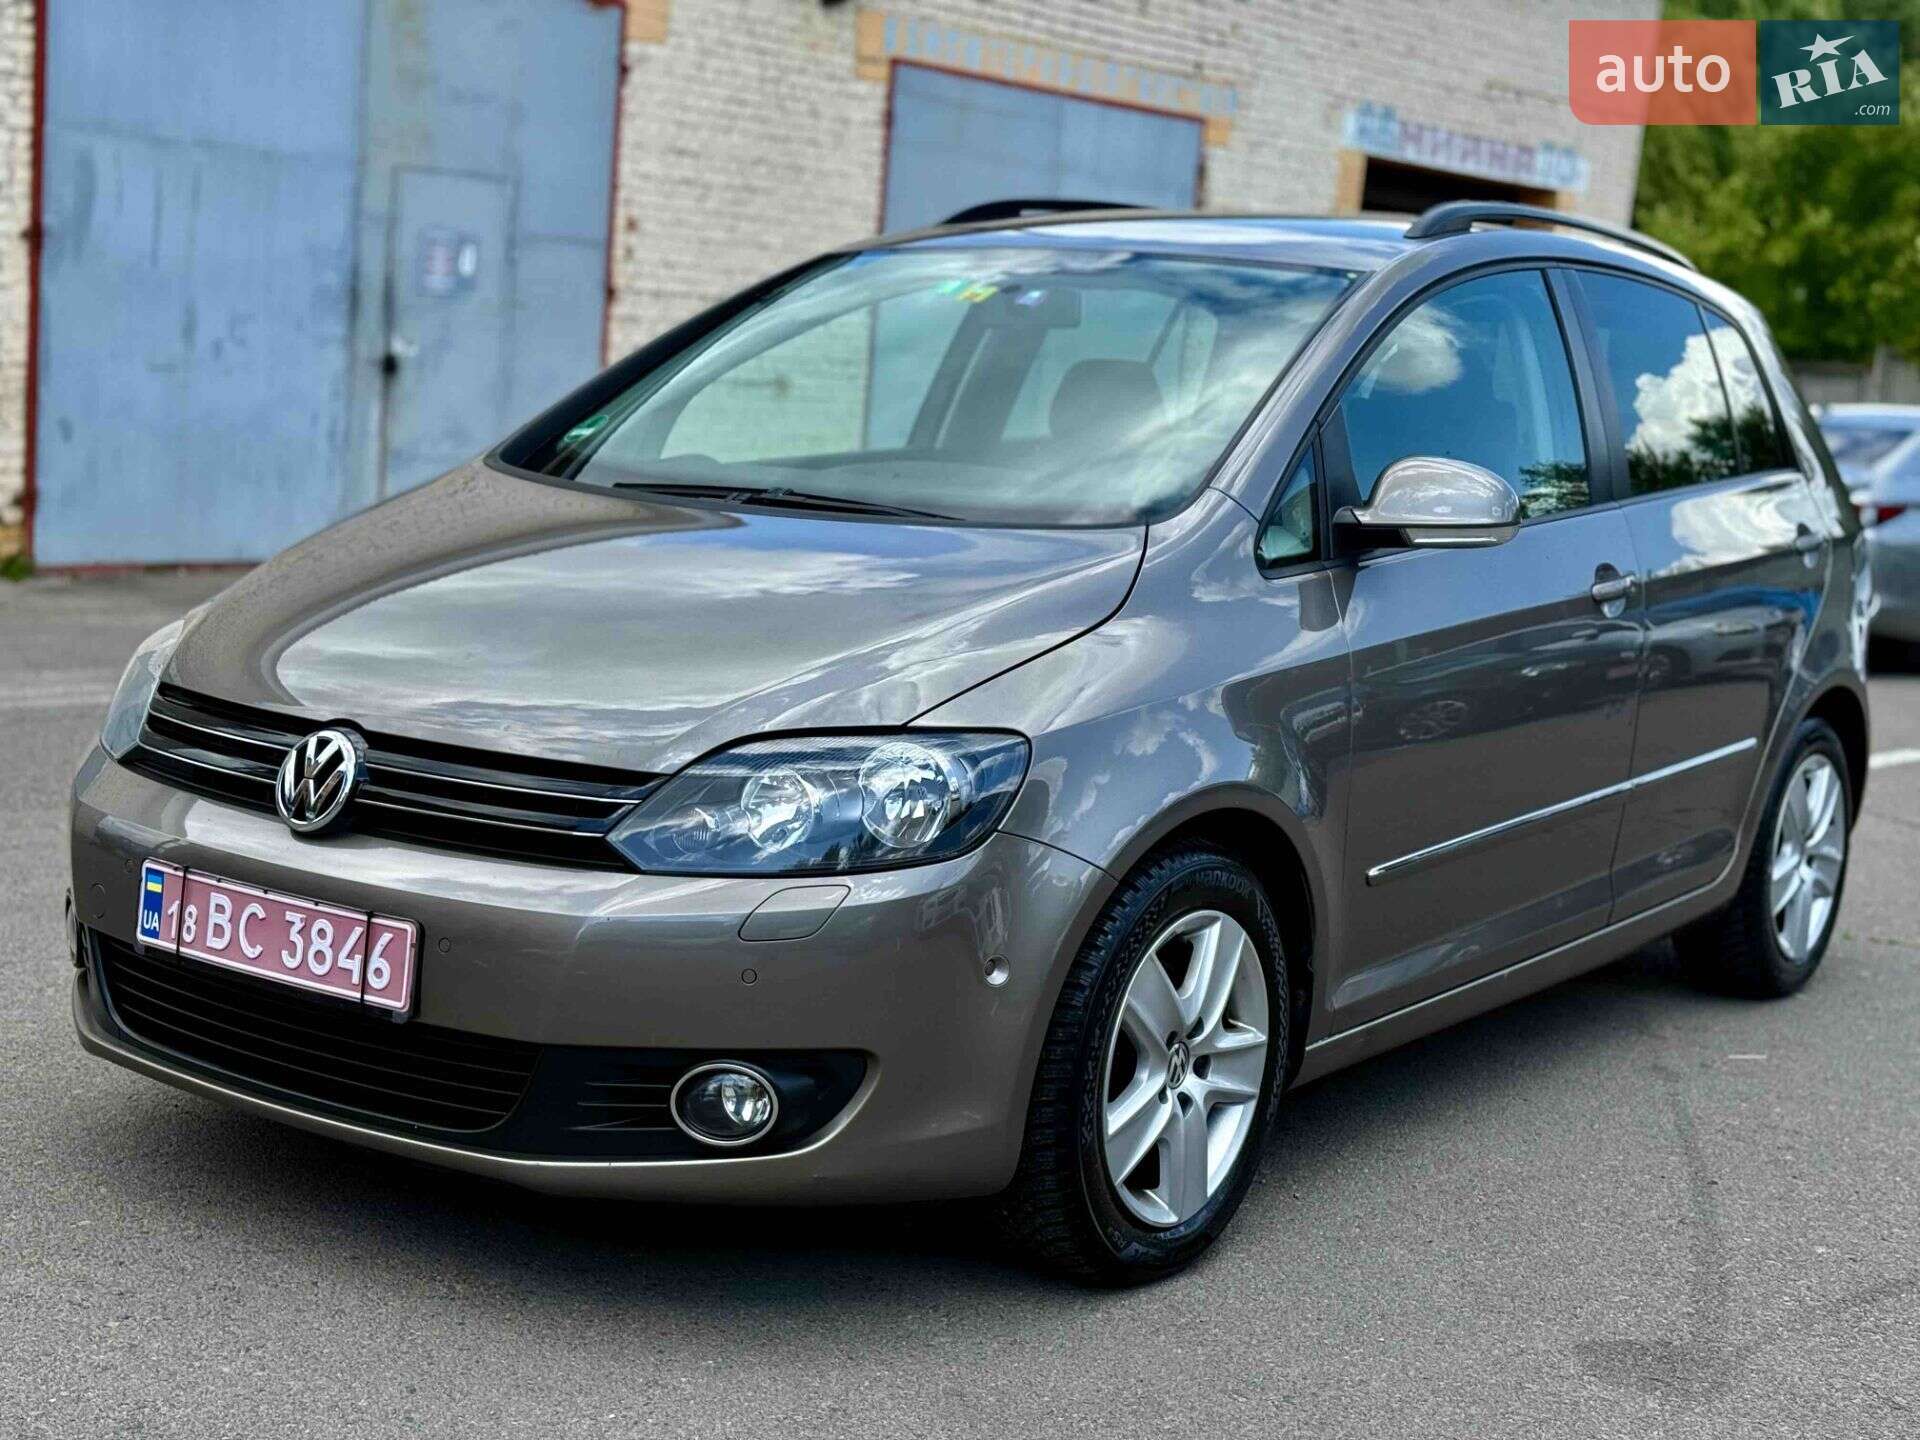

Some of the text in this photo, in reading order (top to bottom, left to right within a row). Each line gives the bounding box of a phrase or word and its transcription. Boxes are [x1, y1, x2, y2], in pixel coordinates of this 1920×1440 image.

[143, 909, 160, 932] UA
[167, 892, 393, 990] 18 BC 3846
